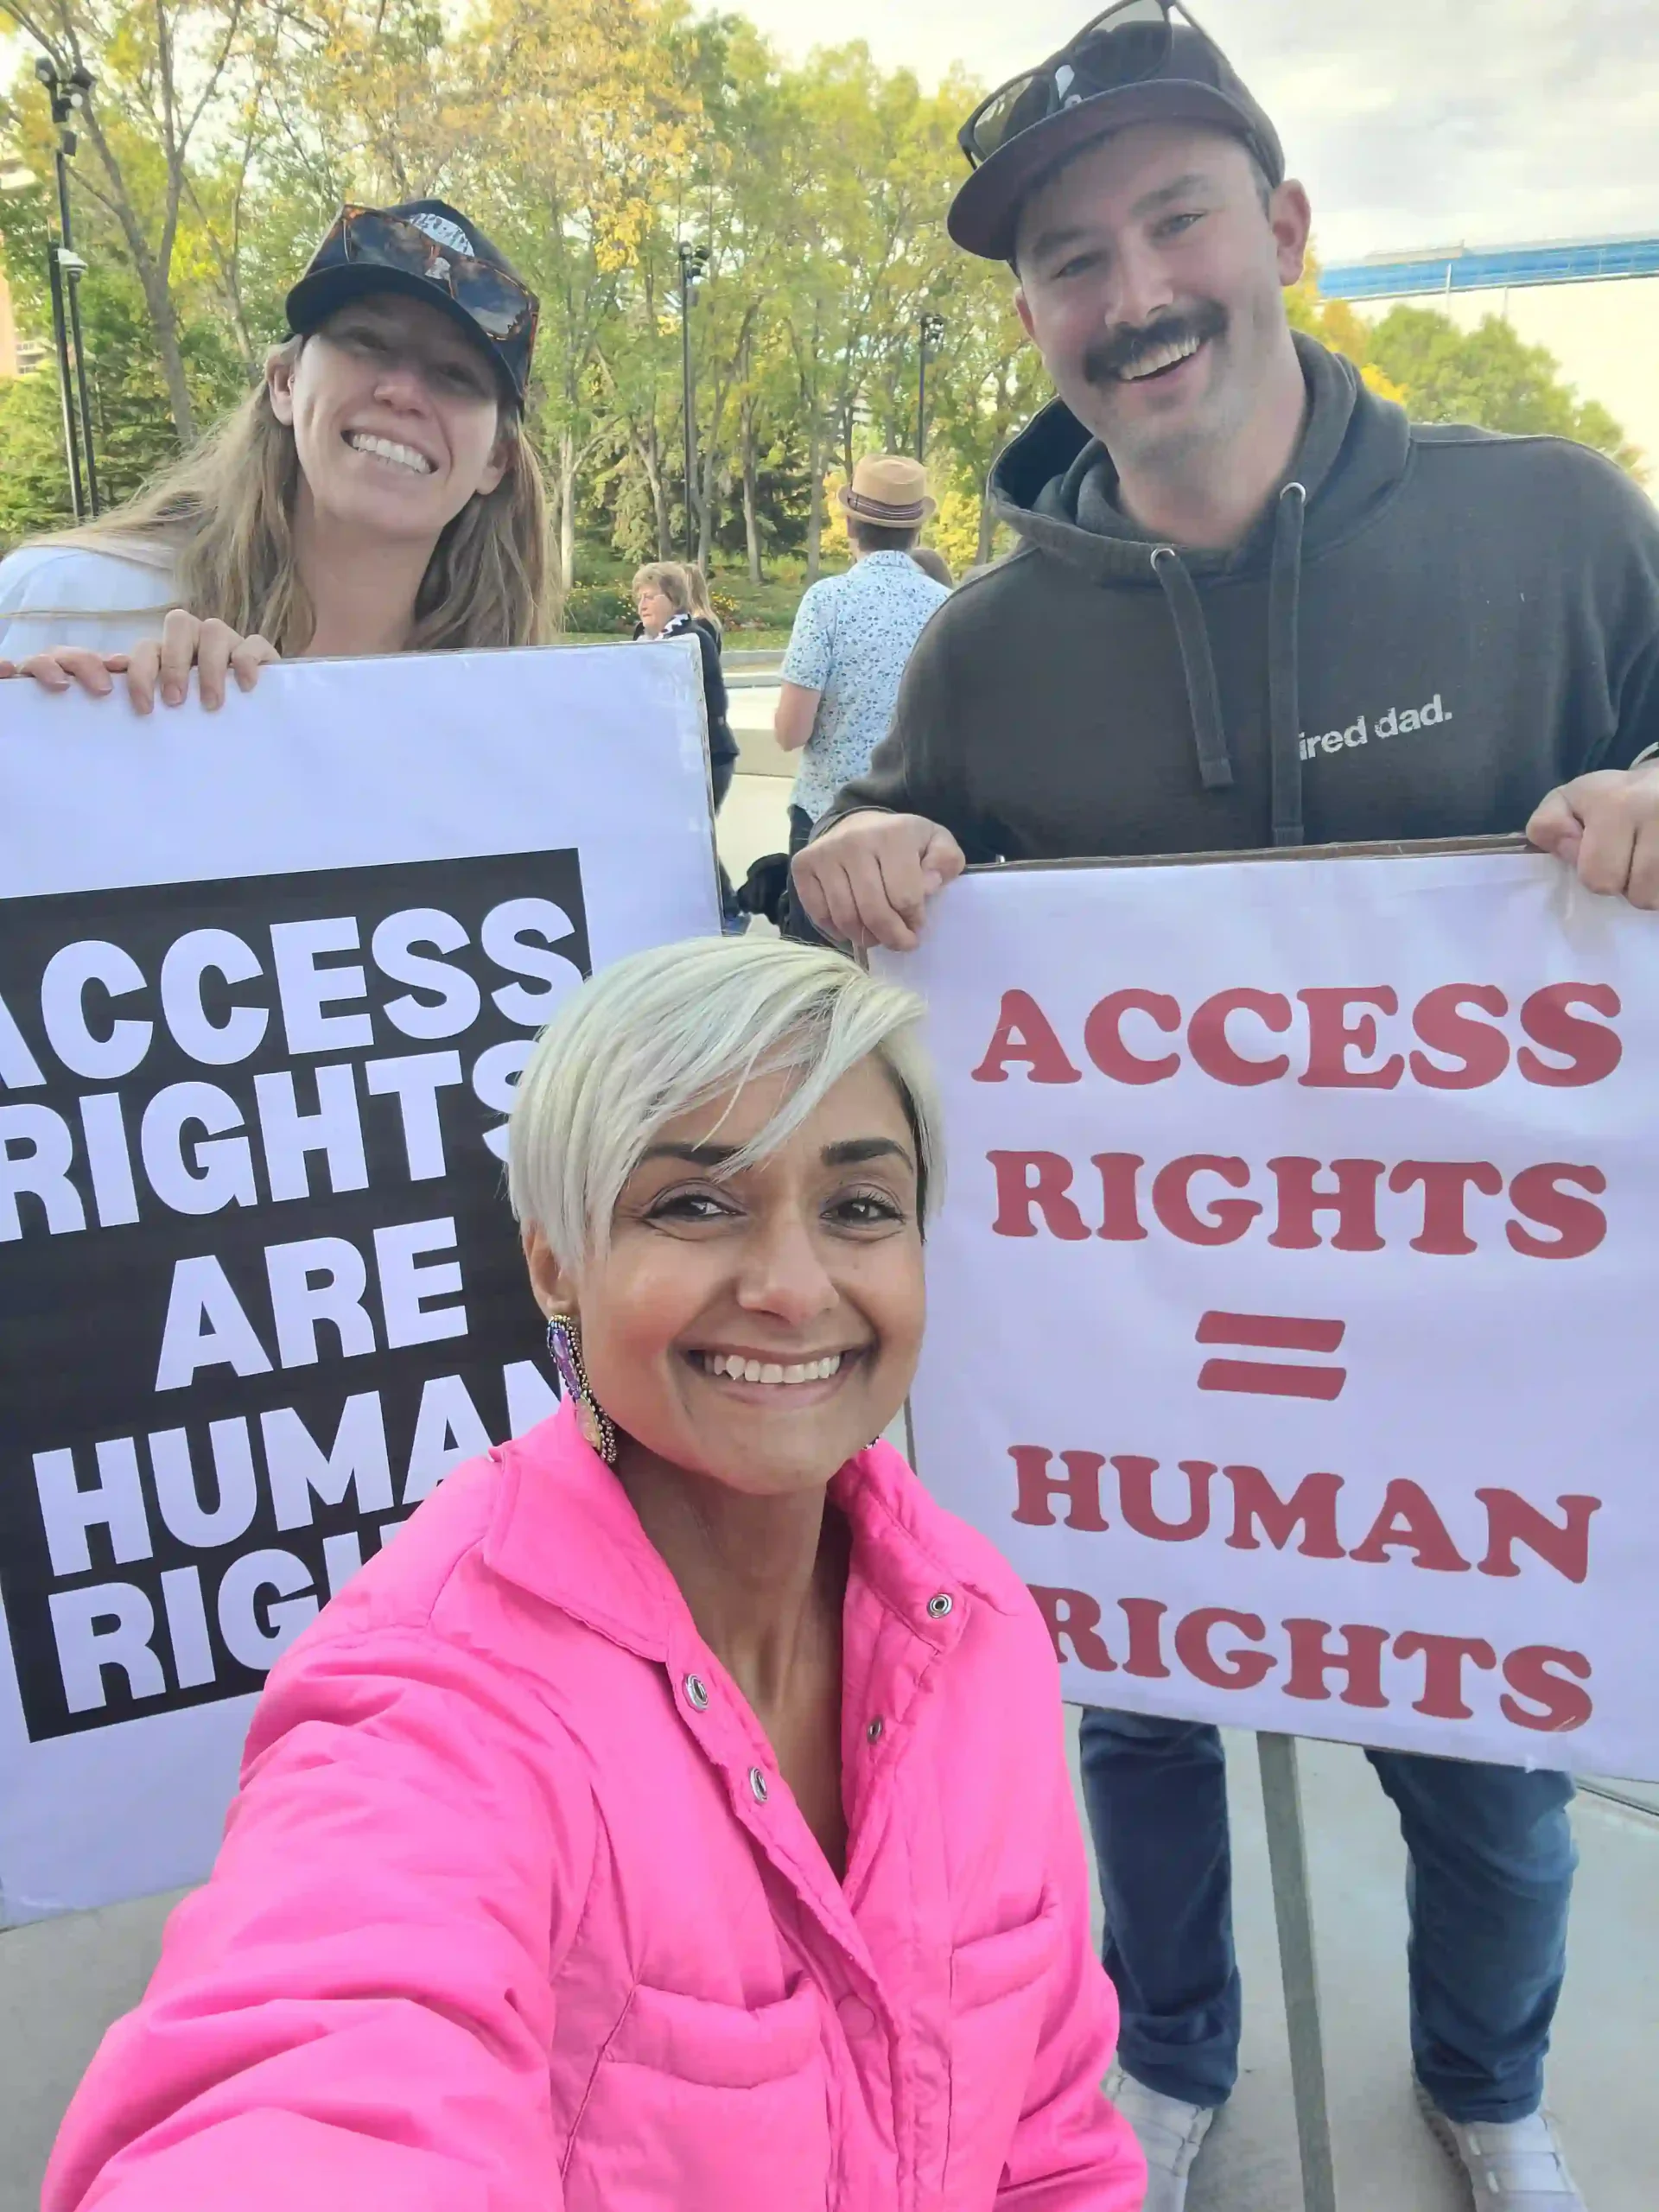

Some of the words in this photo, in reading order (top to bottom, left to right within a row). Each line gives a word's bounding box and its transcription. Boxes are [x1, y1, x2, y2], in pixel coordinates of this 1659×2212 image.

[1299, 715, 1368, 760] ired
[1375, 694, 1452, 739] dad.
[970, 982, 1623, 1090] ACCESS
[985, 1150, 1607, 1260] RIGHTS
[155, 1217, 468, 1391] ARE
[1007, 1445, 1602, 1584] HUMAN
[48, 1518, 410, 1714] RIG
[1026, 1584, 1593, 1732] RIGHTS
